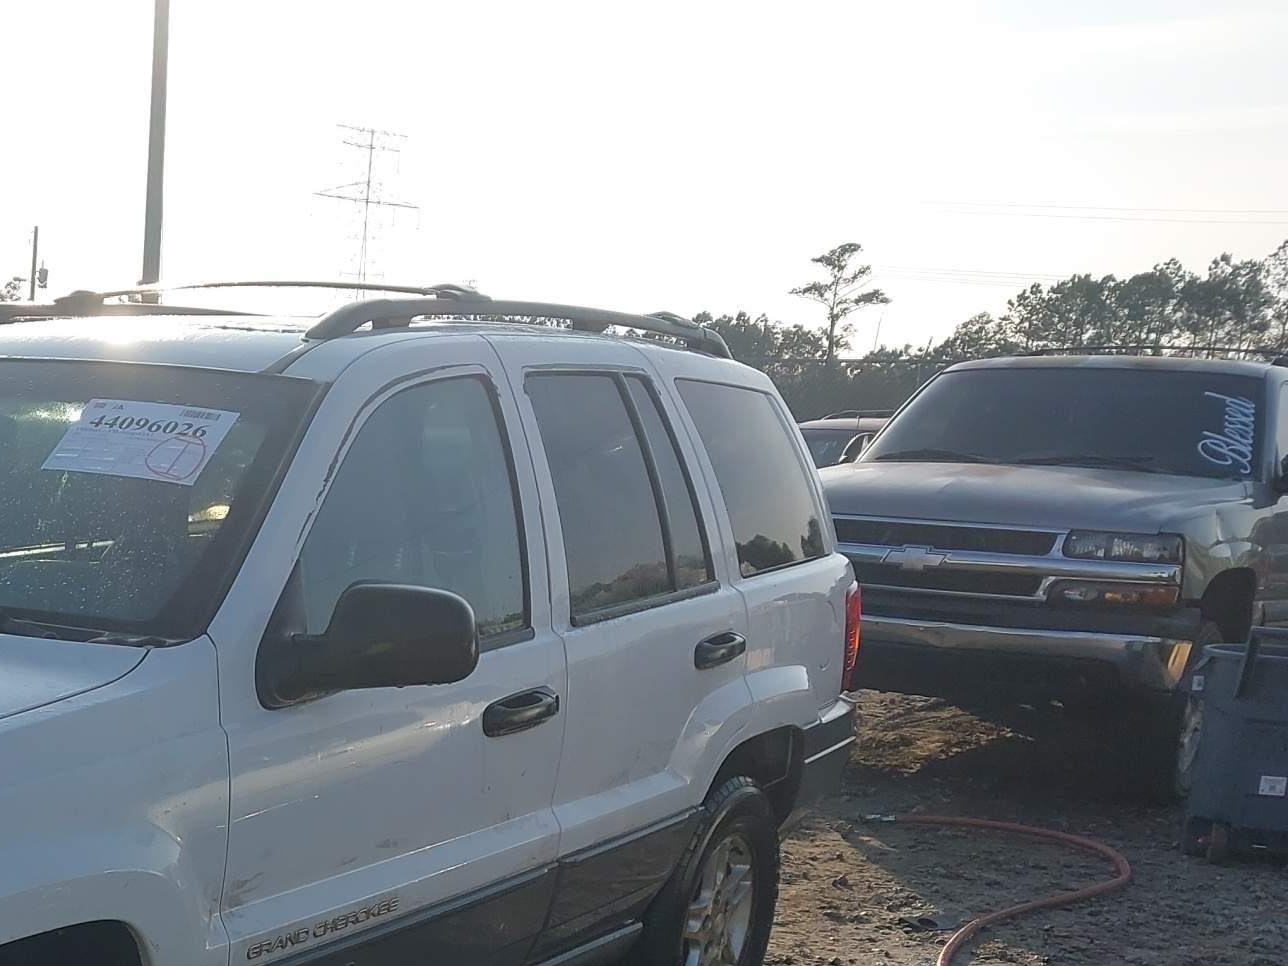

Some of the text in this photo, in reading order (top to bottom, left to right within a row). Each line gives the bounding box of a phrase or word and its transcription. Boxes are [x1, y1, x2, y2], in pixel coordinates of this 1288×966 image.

[89, 414, 208, 438] 44096026
[1198, 391, 1255, 474] Blessed
[247, 897, 401, 960] GRAND CHEROKEE
